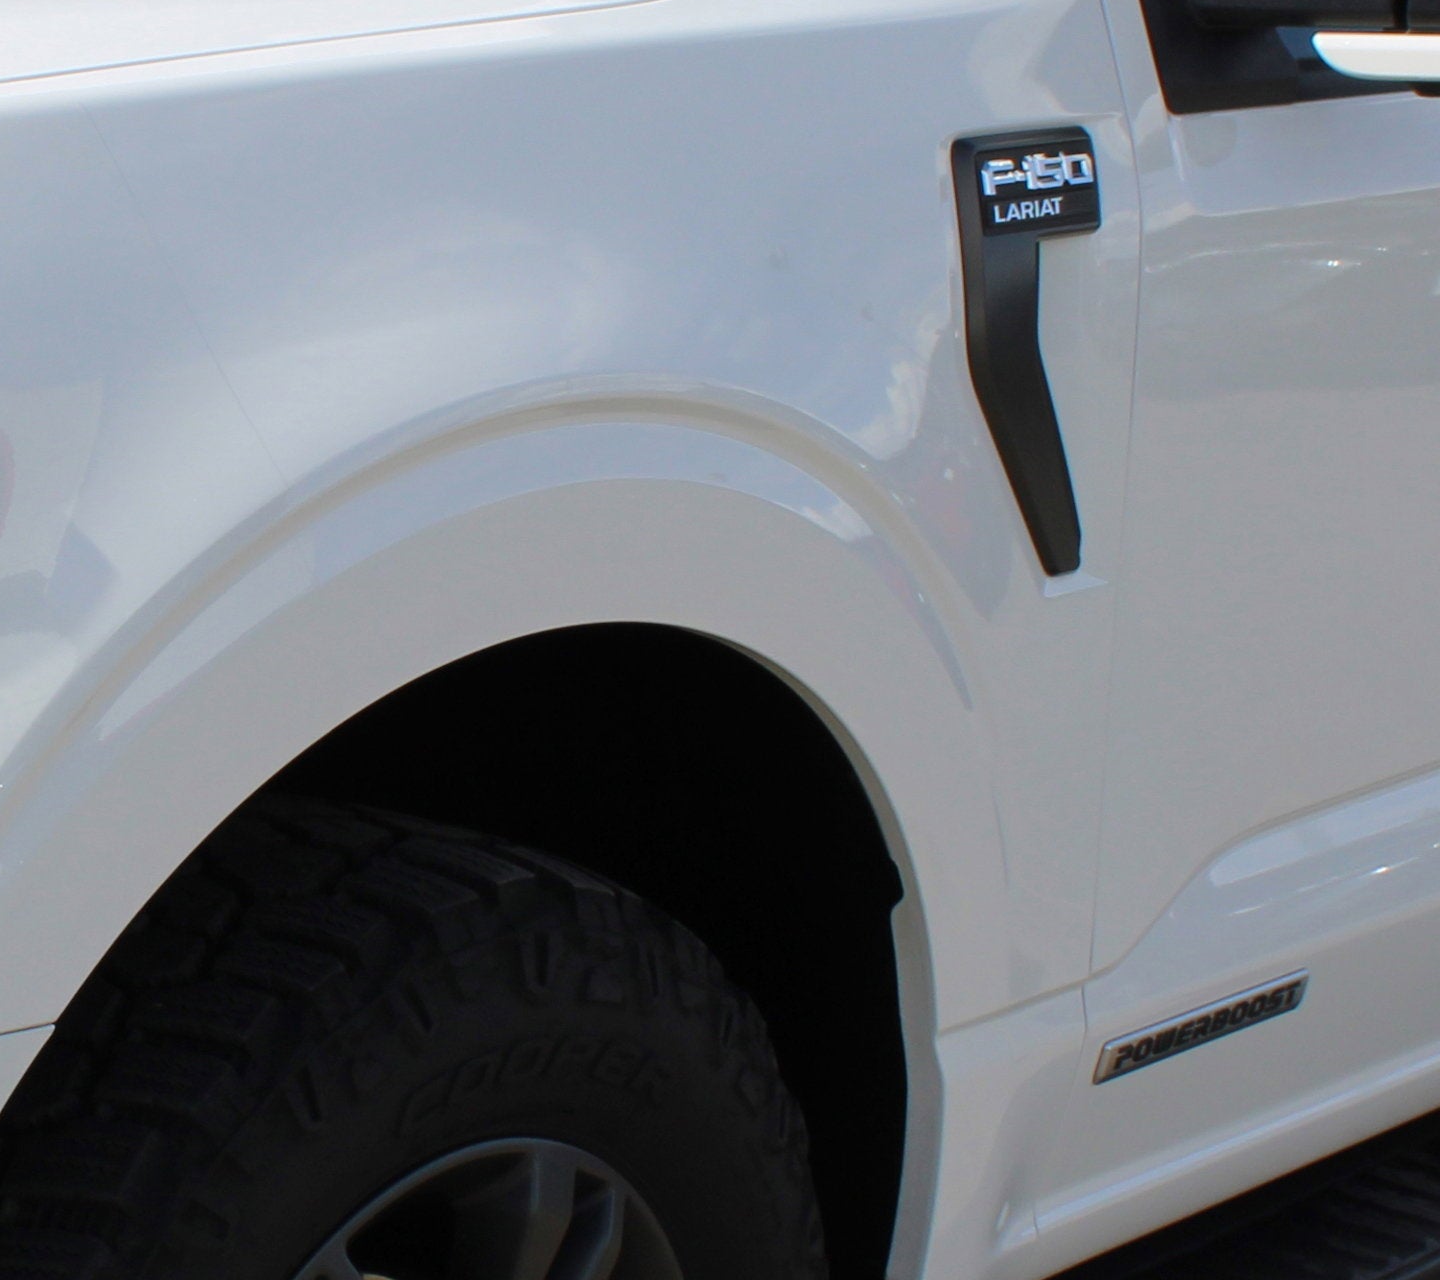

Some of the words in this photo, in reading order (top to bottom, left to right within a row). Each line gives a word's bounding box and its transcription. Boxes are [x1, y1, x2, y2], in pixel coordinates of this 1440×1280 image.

[981, 151, 1094, 196] F-150
[993, 197, 1063, 223] LARIAT
[1114, 980, 1301, 1070] POWERBOOST
